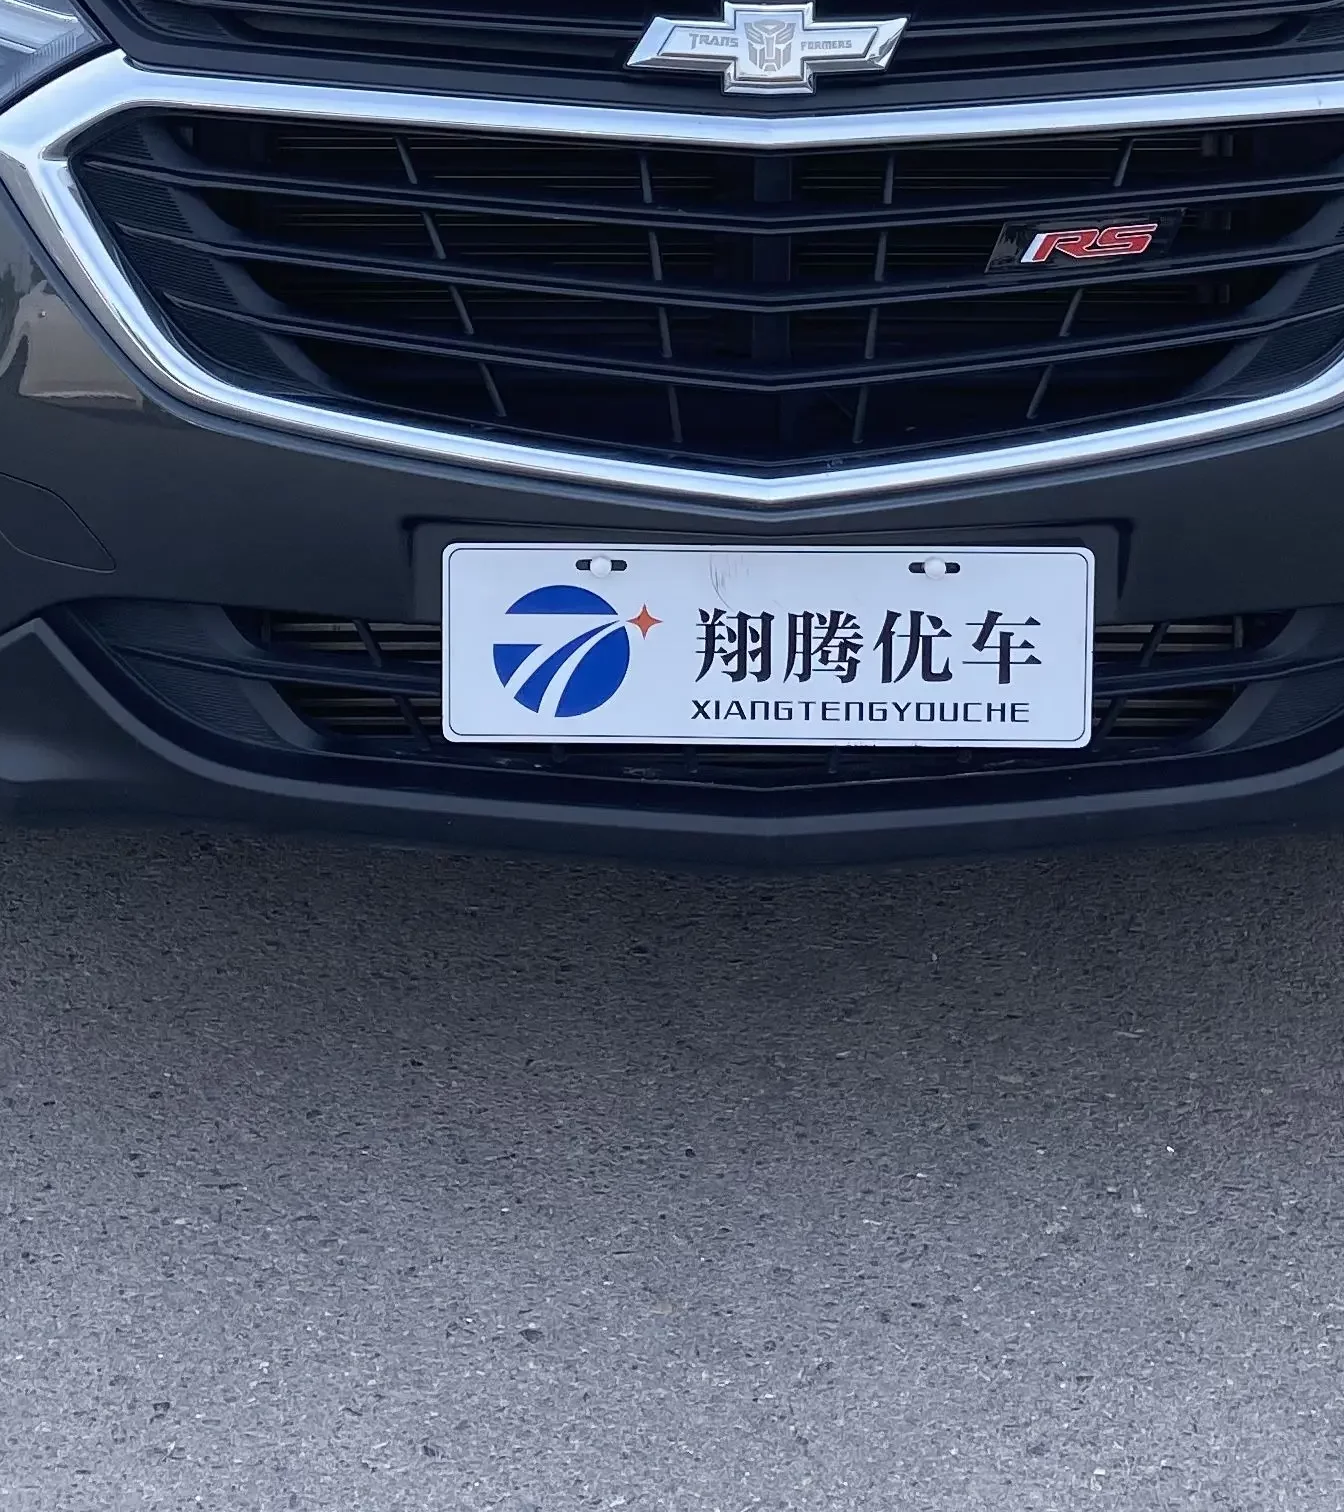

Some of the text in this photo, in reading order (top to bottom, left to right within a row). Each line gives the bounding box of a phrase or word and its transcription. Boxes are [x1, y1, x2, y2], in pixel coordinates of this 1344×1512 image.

[800, 38, 852, 51] FORMERS
[1021, 223, 1158, 263] RS
[693, 607, 1043, 685] 翔腾优车
[690, 699, 1030, 724] XIANGTENGYOUCHE
